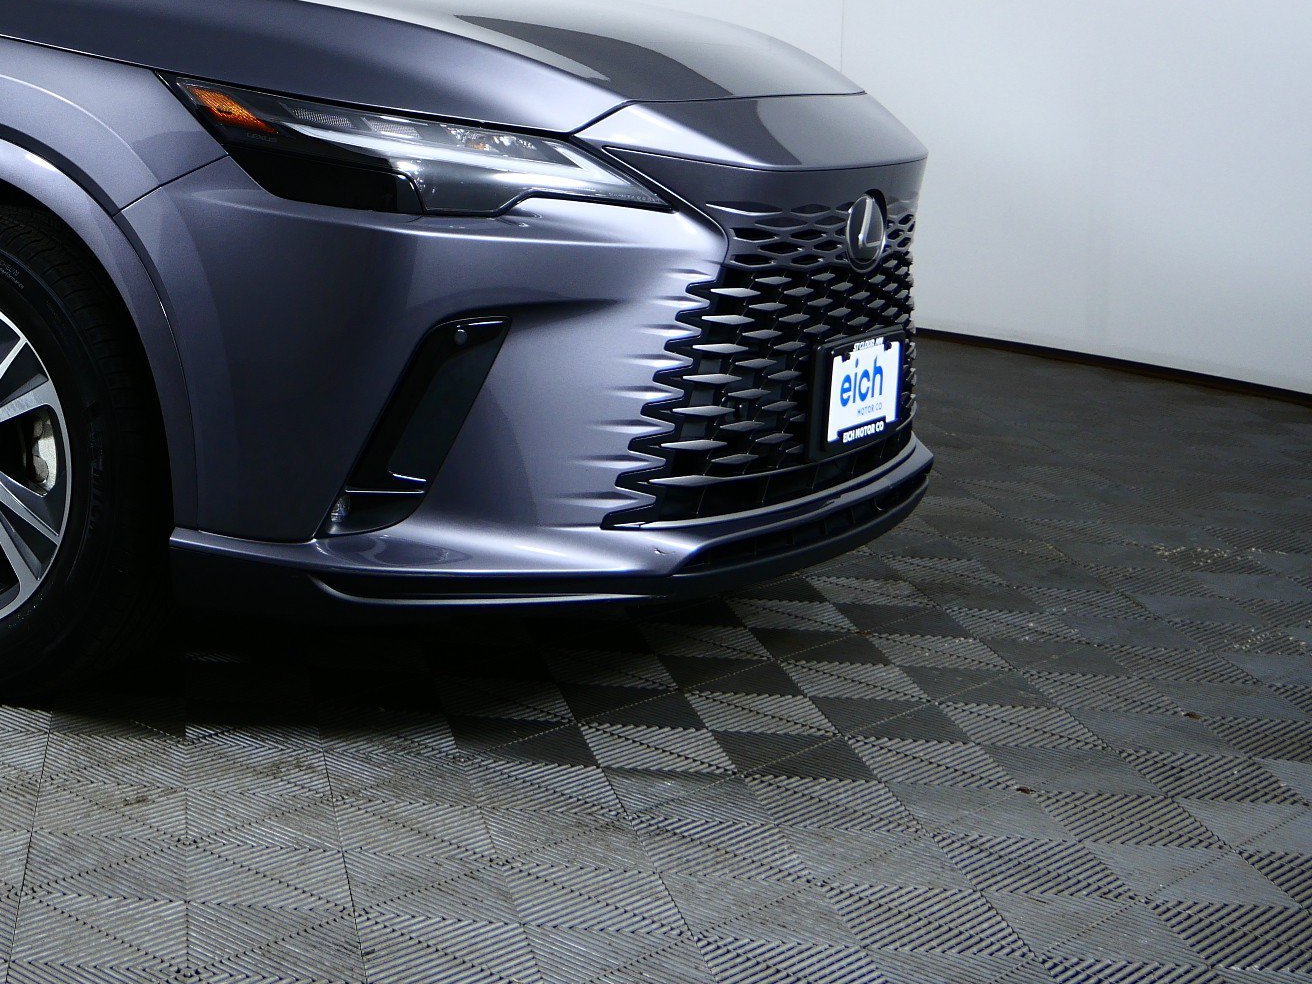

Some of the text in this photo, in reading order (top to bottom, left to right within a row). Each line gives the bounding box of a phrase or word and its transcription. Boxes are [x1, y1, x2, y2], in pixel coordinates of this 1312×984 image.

[840, 356, 883, 407] eich
[857, 402, 883, 416] MOTOR CO
[843, 421, 884, 443] EICH MOTOR CO
